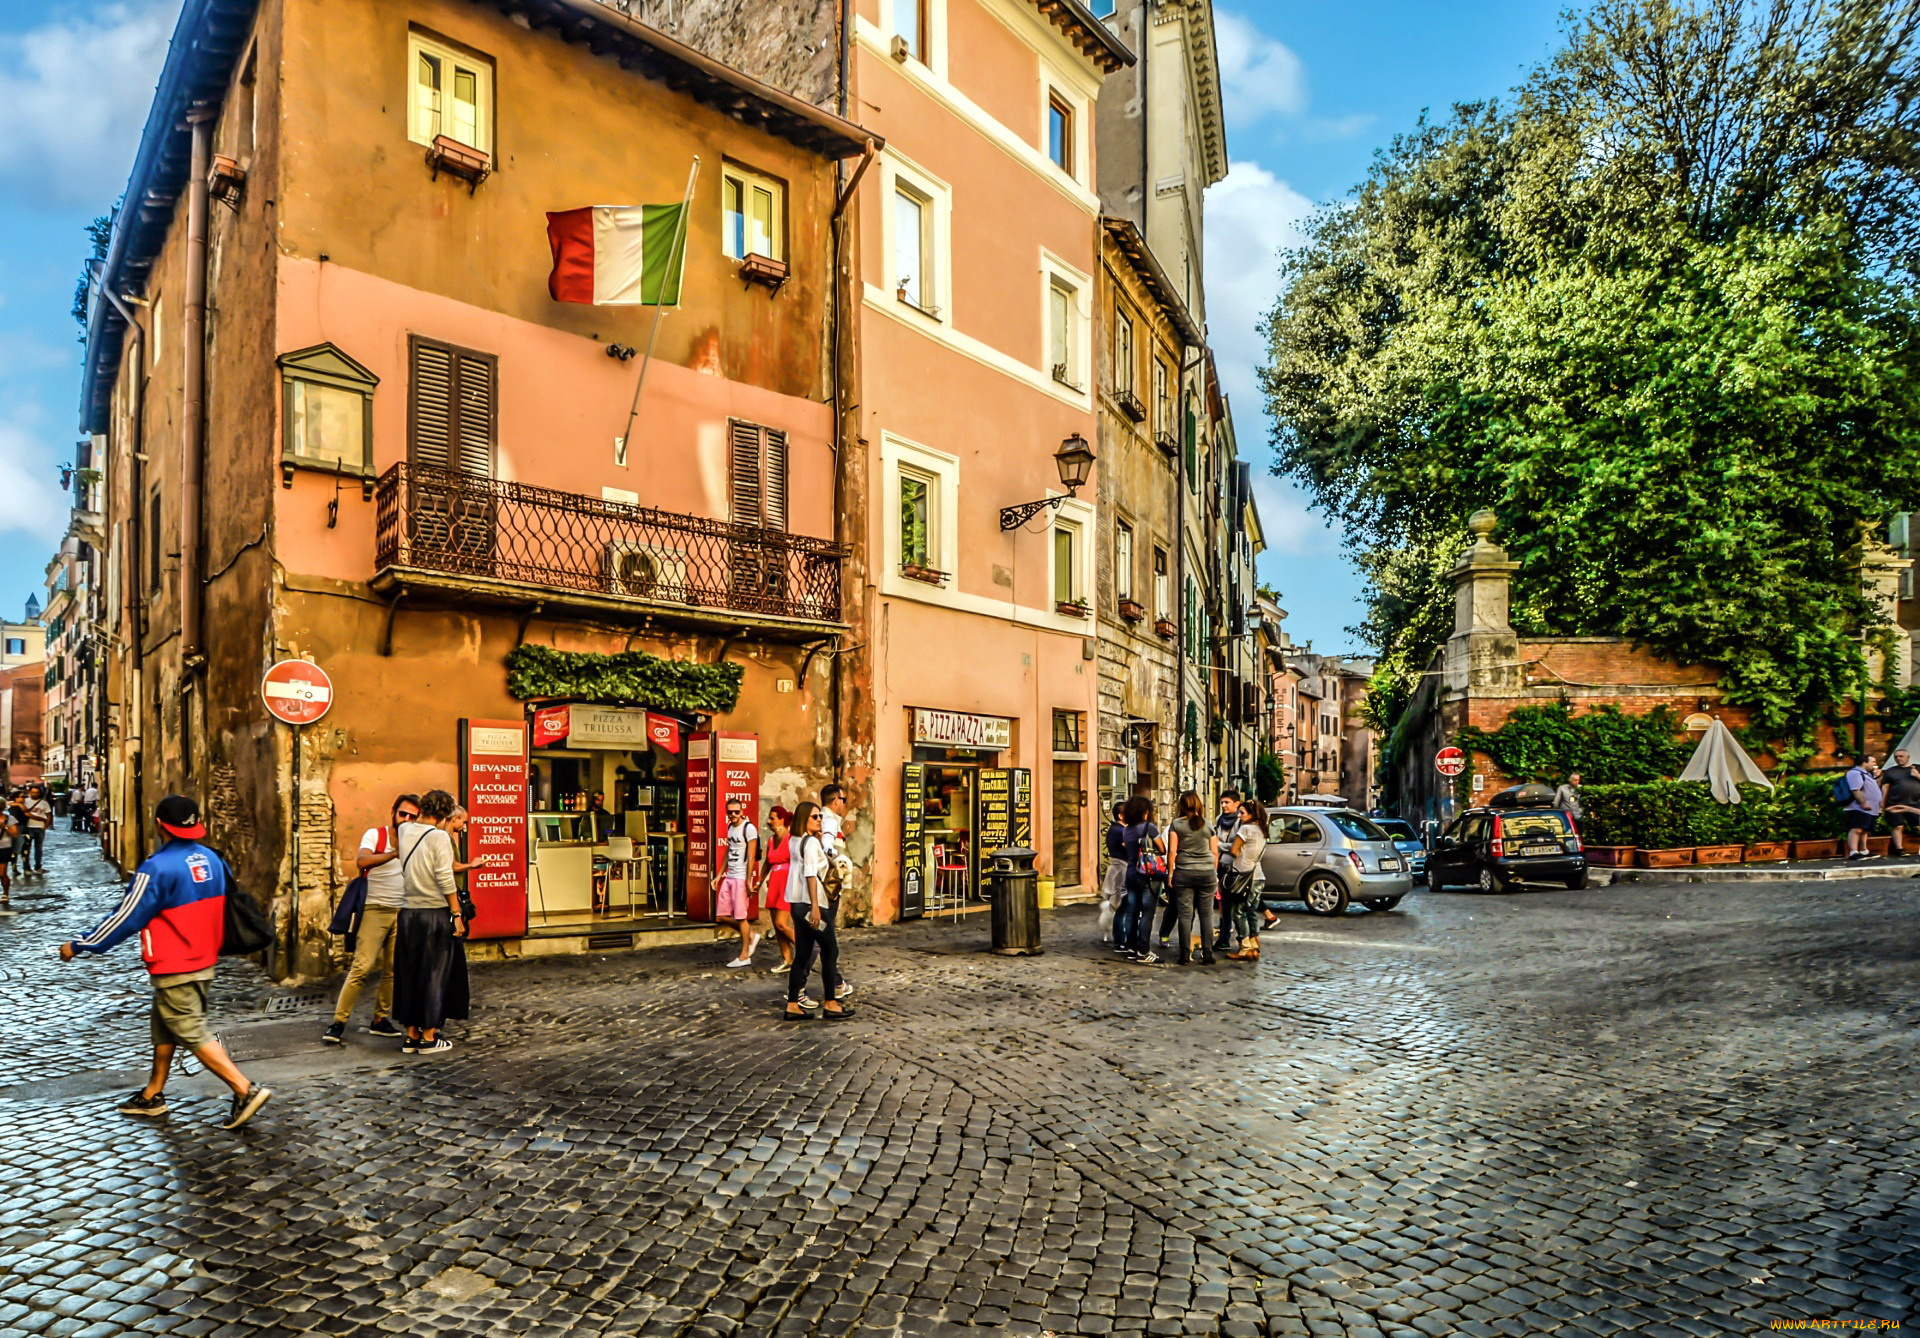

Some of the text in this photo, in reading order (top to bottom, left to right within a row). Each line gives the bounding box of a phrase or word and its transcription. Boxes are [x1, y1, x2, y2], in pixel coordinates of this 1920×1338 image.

[593, 714, 623, 723] PIZZA
[583, 723, 633, 734] TRILUSSA
[472, 763, 523, 773] BEVANDE
[726, 770, 751, 779] PIZZA
[472, 783, 523, 792] ALCOLICI
[725, 792, 752, 802] FRITTI
[470, 816, 524, 824] PRODOTTI
[481, 825, 513, 834] TIPICI
[690, 841, 707, 850] DOLCI
[481, 853, 514, 861] DOLCI
[689, 863, 707, 872] GELATI
[478, 872, 517, 881] GELATI
